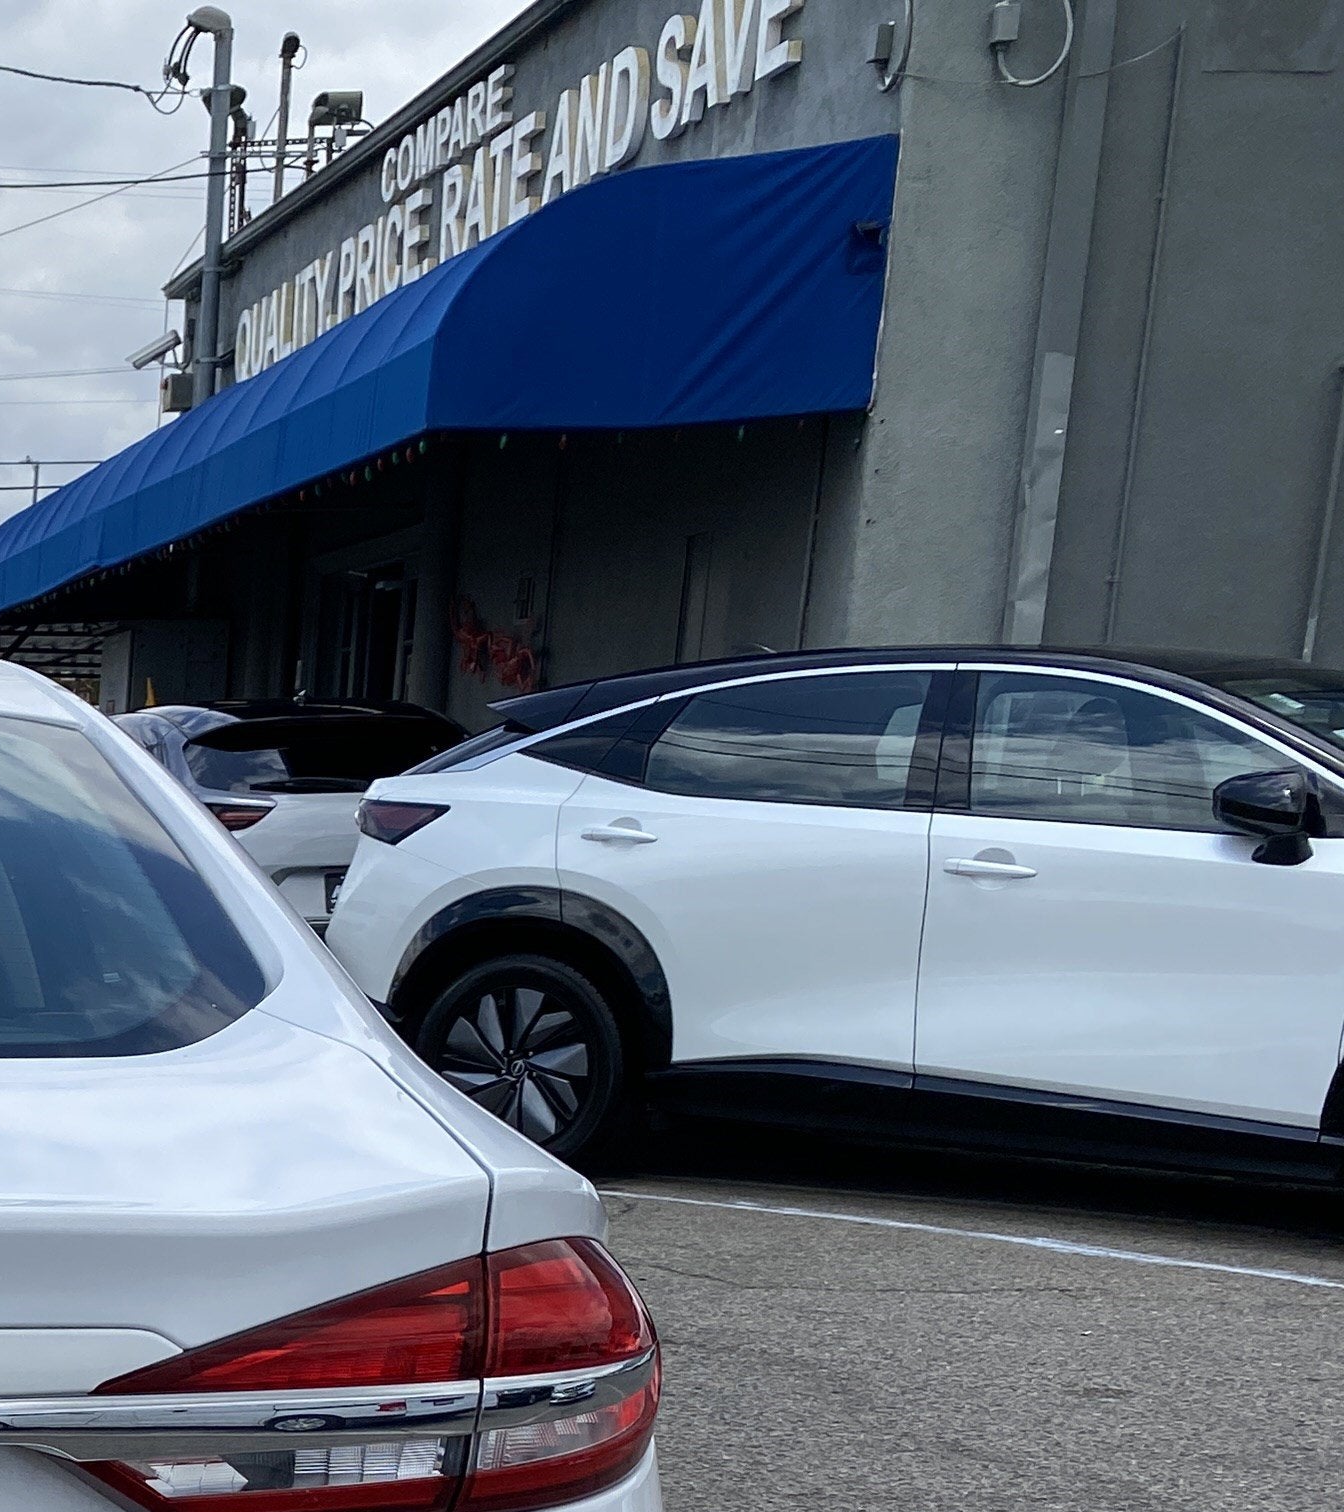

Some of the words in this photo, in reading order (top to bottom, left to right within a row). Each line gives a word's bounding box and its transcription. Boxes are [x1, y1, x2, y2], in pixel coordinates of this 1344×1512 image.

[381, 64, 515, 202] COMPARE
[439, 111, 546, 264] RATE
[540, 45, 650, 206] AND
[651, 0, 804, 140] SAVE
